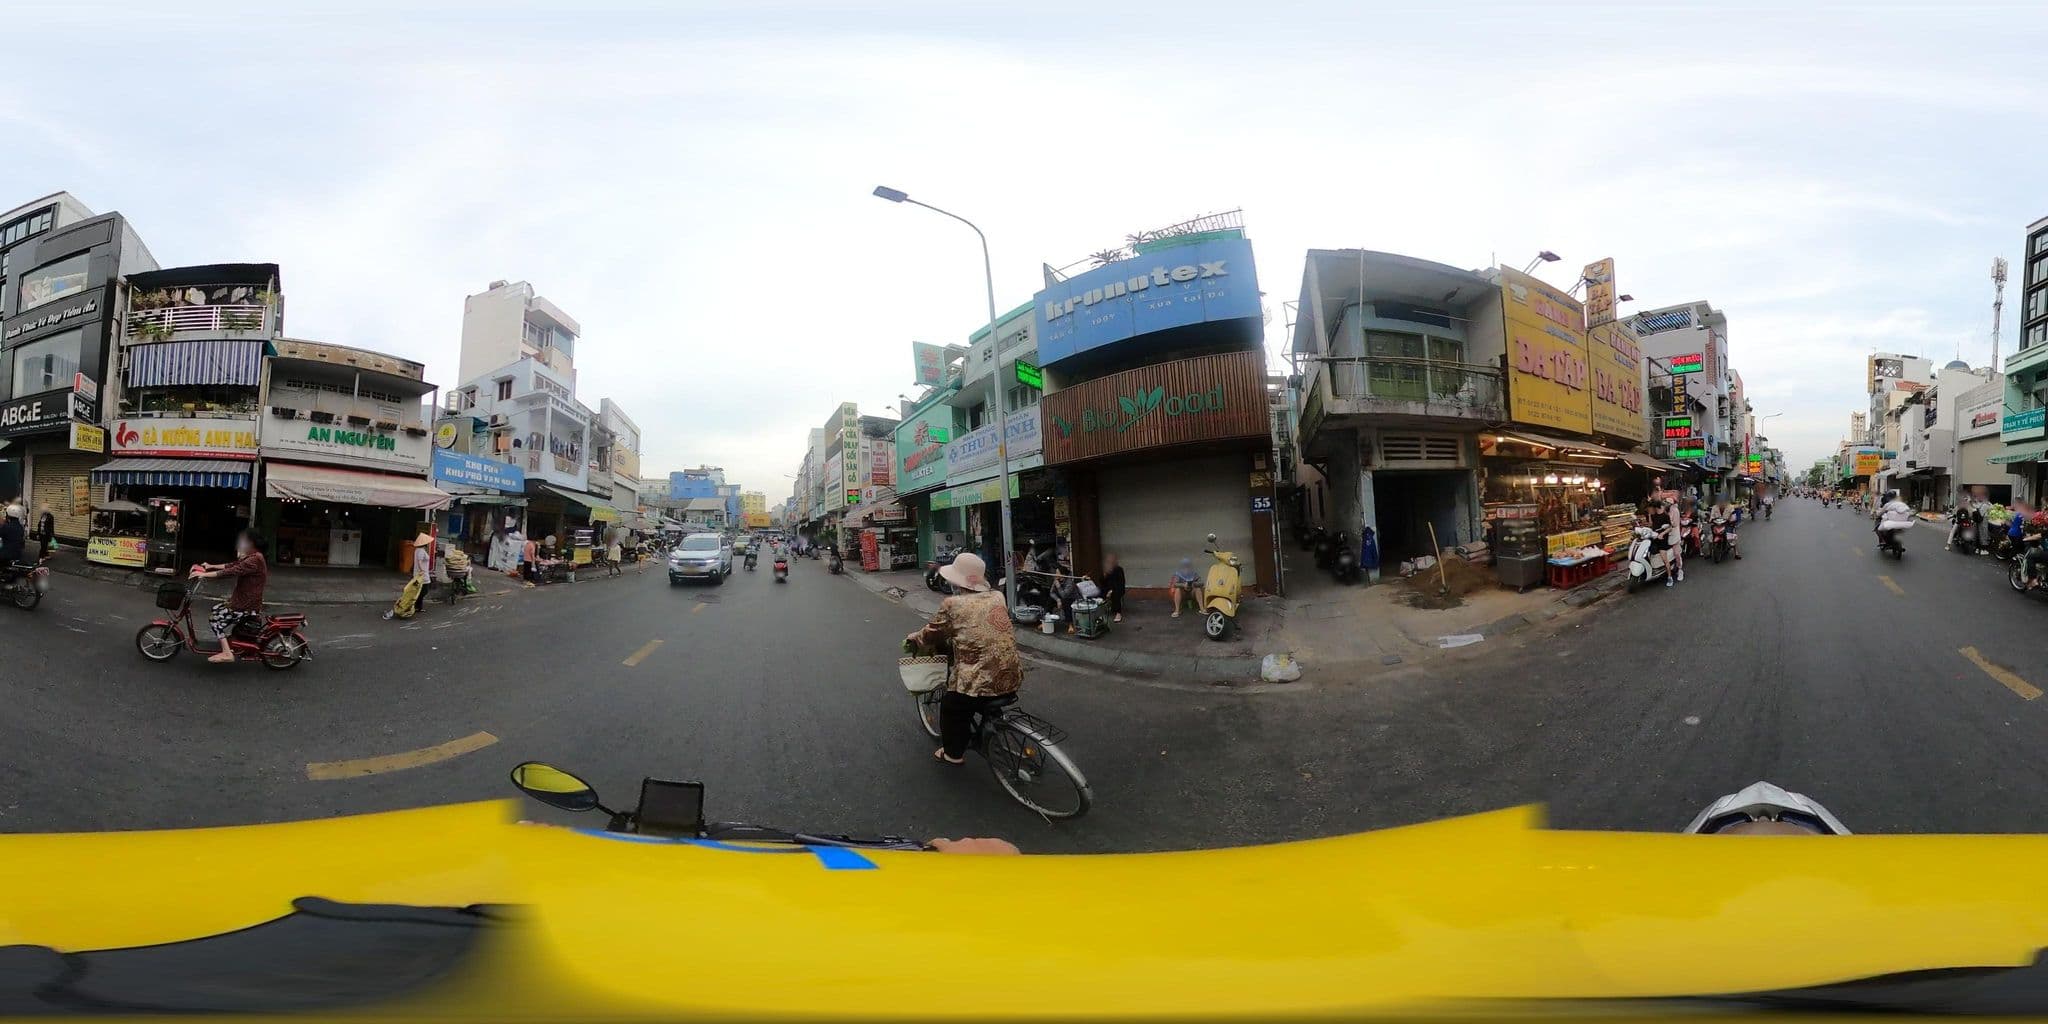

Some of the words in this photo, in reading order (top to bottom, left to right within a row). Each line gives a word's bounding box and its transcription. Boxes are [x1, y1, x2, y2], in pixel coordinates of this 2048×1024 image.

[1516, 336, 1551, 380] BA
[1550, 349, 1585, 396] TẬP
[1595, 367, 1617, 405] BA
[1673, 376, 1686, 412] SENK
[143, 426, 158, 446] GÀ
[162, 424, 200, 447] NƯỚNG
[205, 429, 231, 448] ANH
[308, 426, 332, 443] AN
[334, 428, 397, 451] NGUYÊN
[960, 437, 986, 453] THU
[1254, 497, 1271, 509] 55
